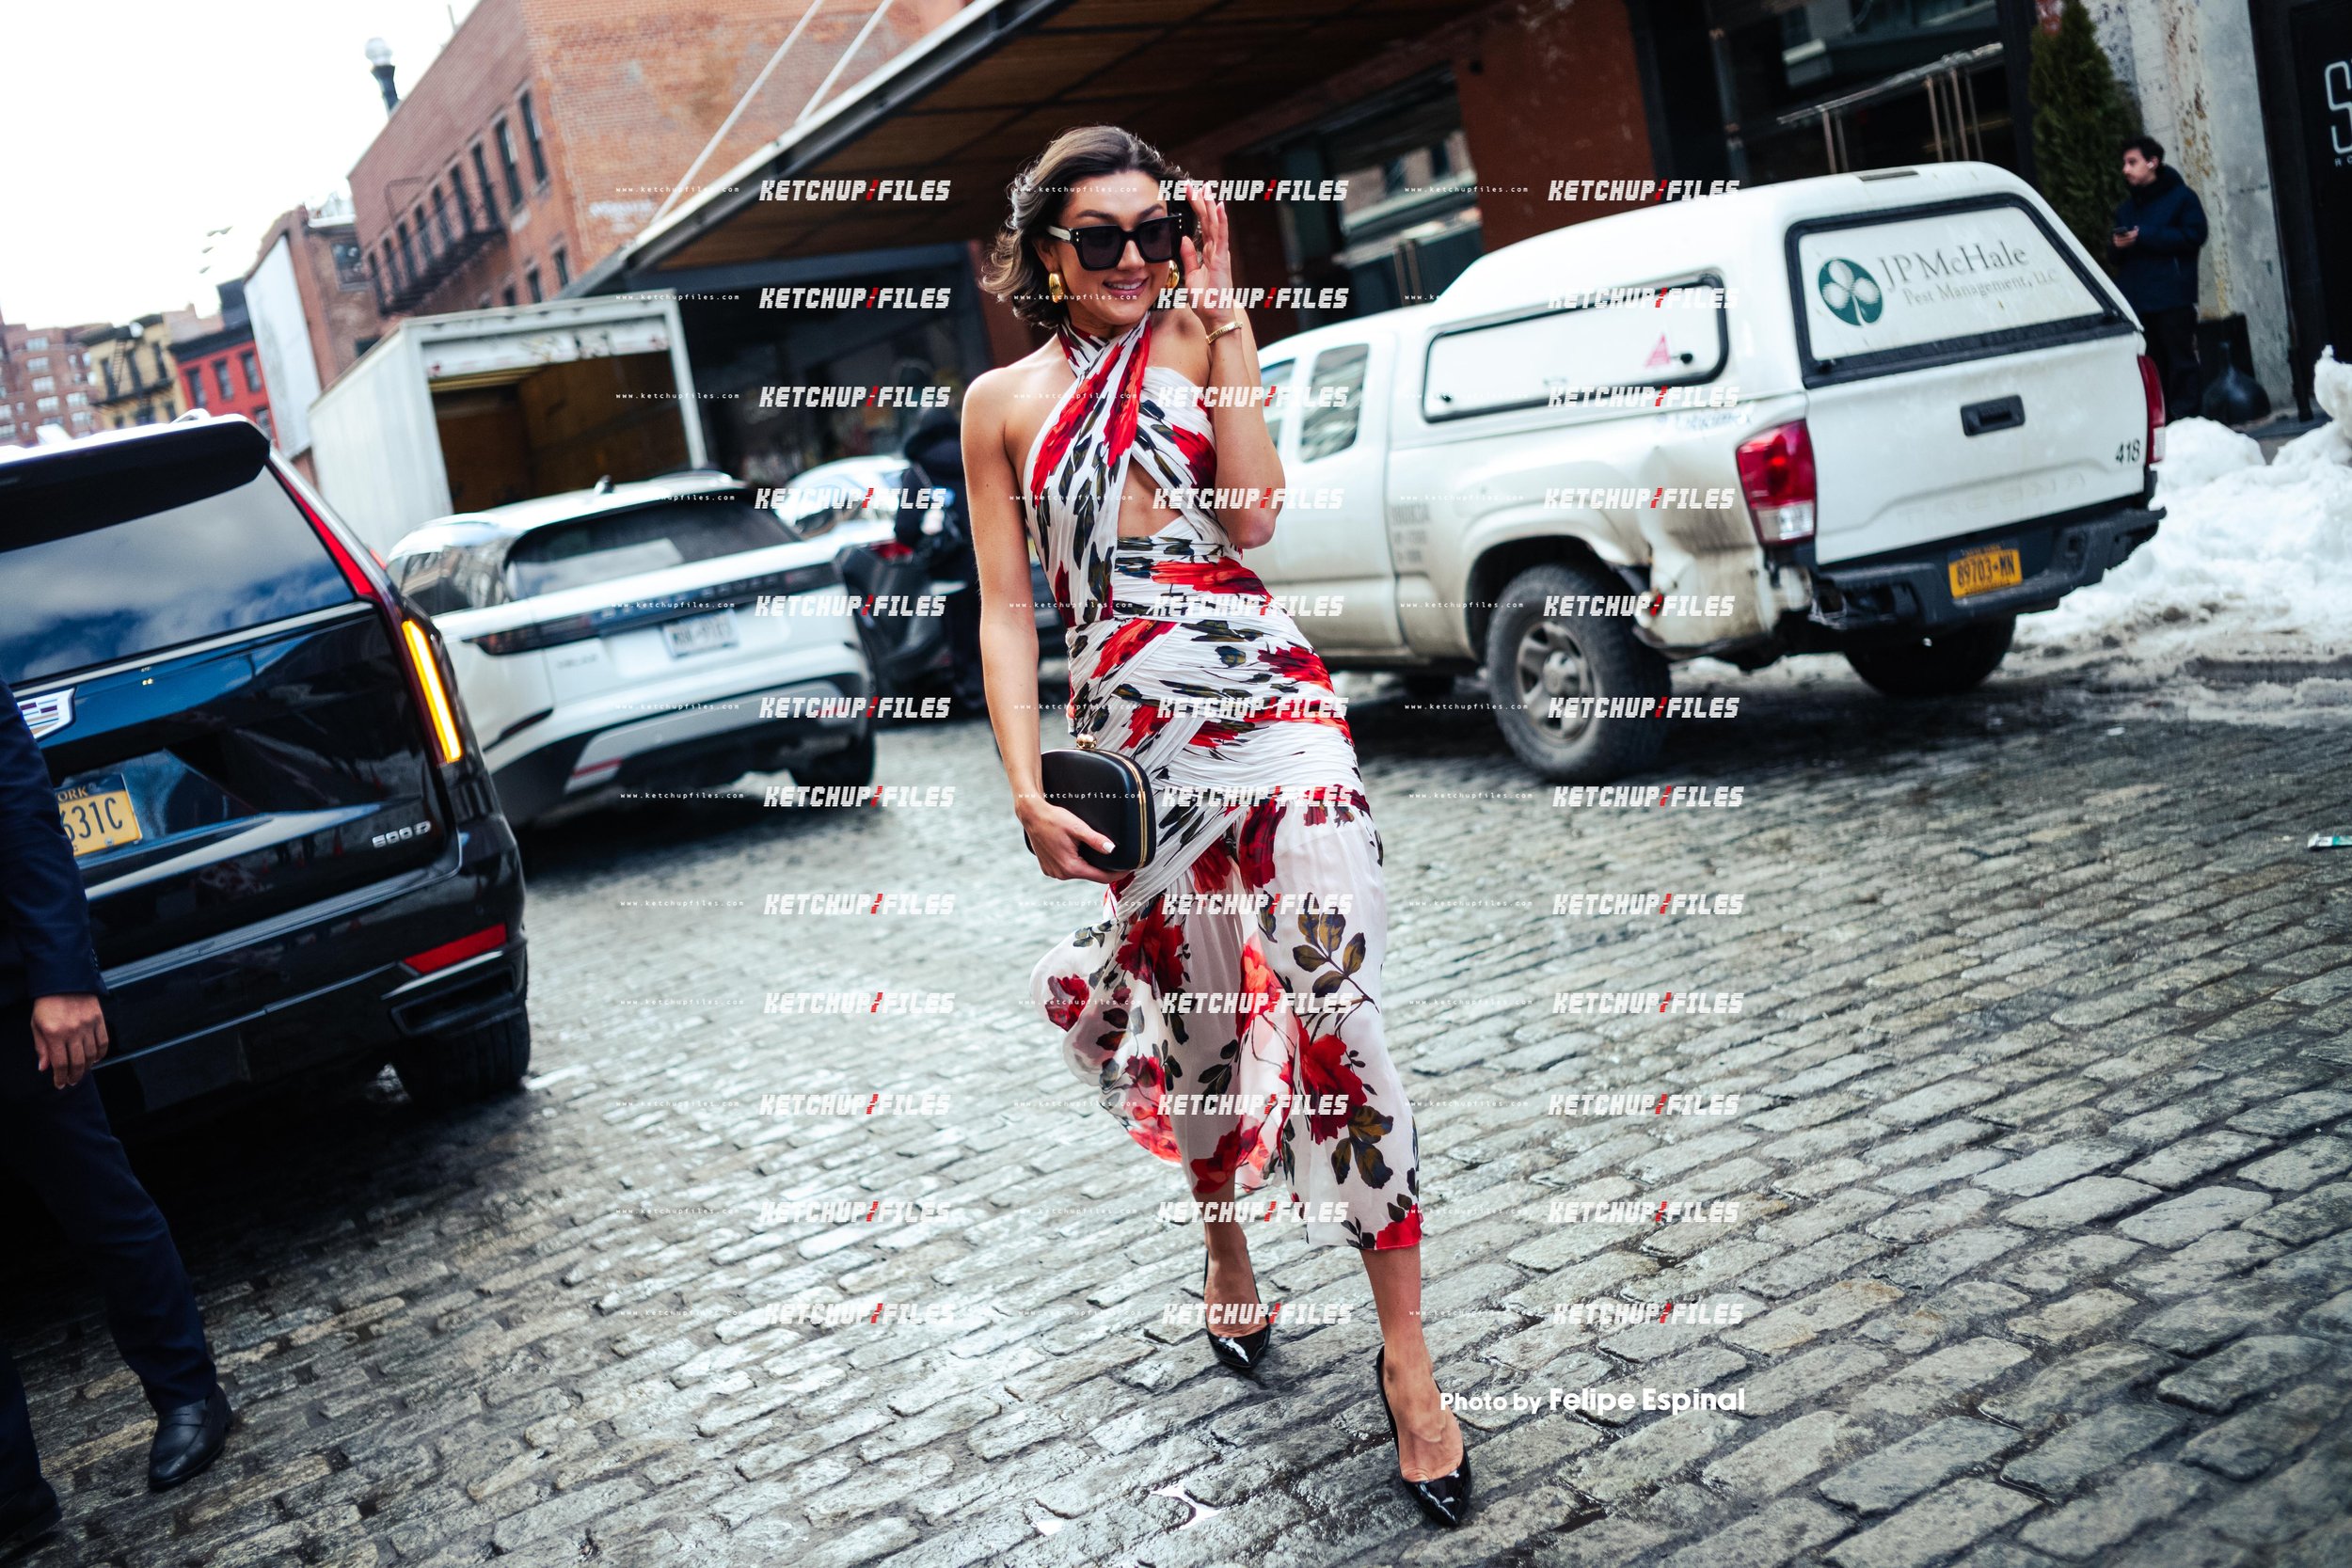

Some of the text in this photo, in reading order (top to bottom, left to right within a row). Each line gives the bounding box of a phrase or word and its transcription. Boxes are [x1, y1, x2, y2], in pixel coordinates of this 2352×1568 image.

[1902, 287, 1935, 307] Pest
[2115, 438, 2140, 464] 418
[57, 786, 88, 802] ORK
